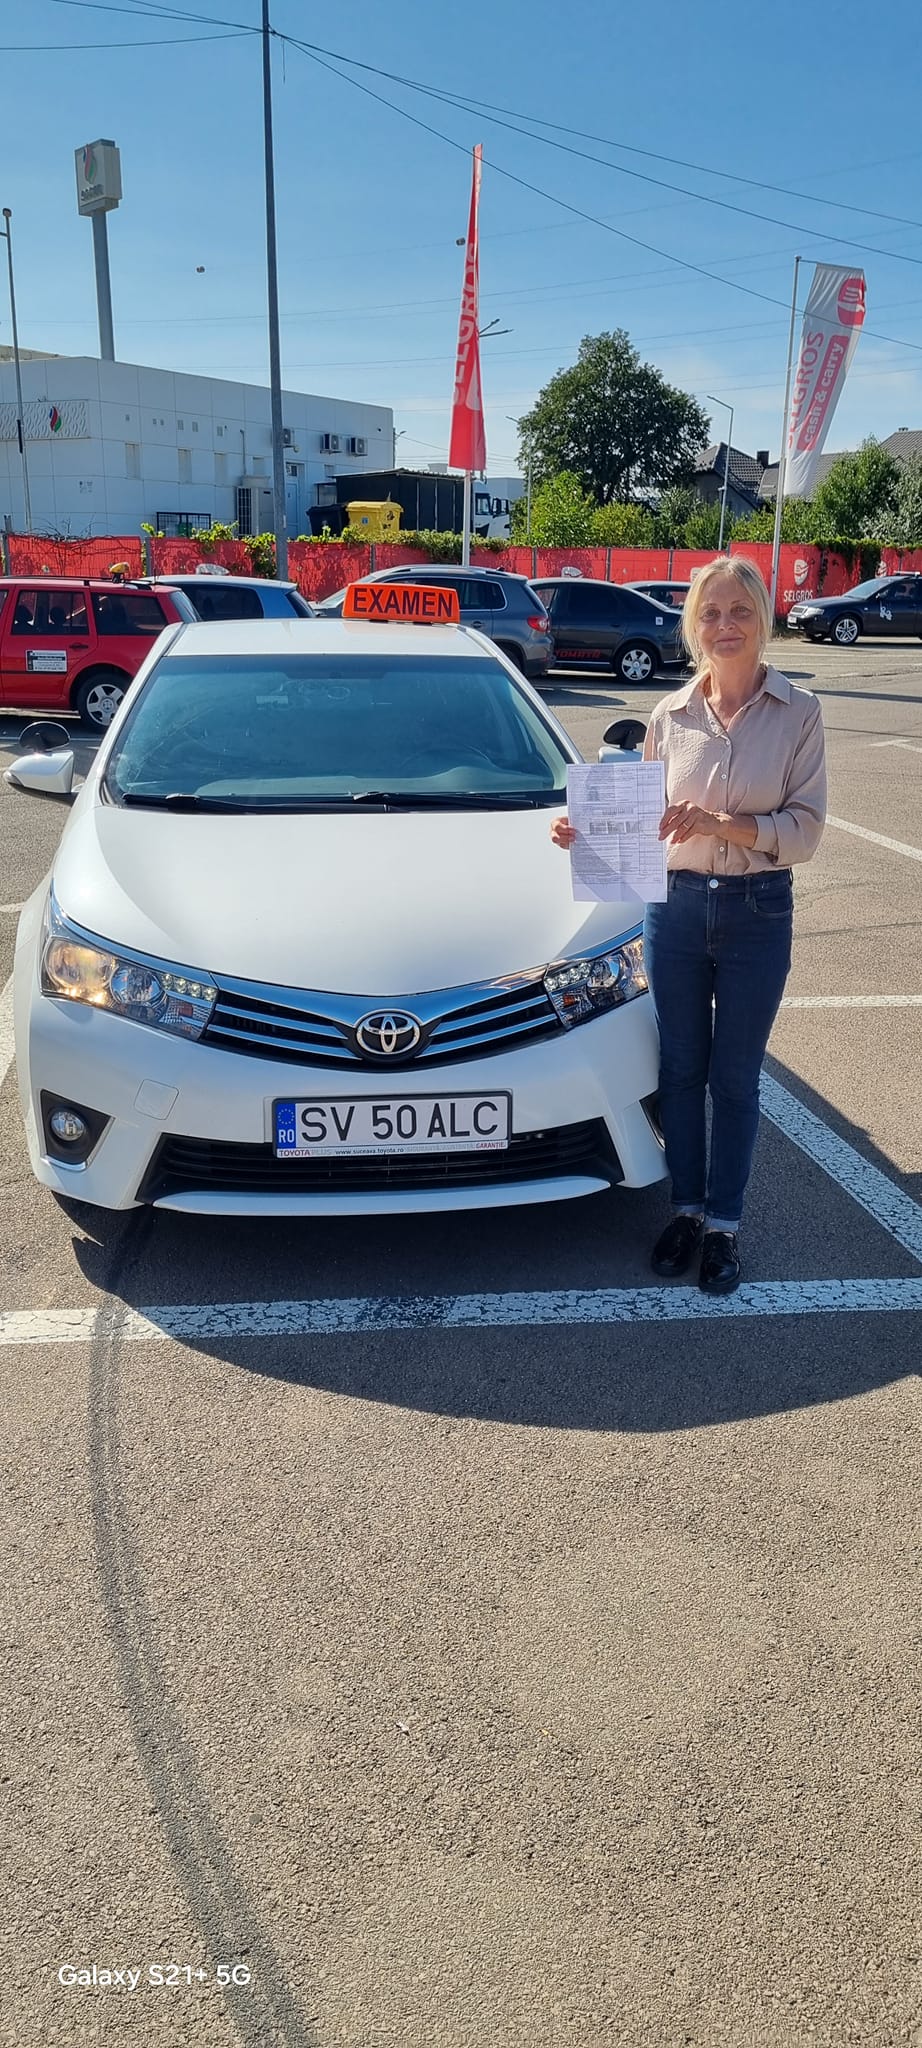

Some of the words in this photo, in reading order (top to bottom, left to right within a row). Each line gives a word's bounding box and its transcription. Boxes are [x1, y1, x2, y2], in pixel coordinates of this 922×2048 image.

[804, 404, 823, 443] cash
[814, 389, 828, 403] &
[821, 342, 844, 387] carry
[353, 588, 452, 617] EXAMEN
[783, 590, 813, 602] SELGROS
[301, 1106, 355, 1142] SV
[372, 1104, 417, 1139] 50
[427, 1101, 498, 1138] ALC
[278, 1129, 295, 1144] RO
[280, 1149, 310, 1157] TOYOTA
